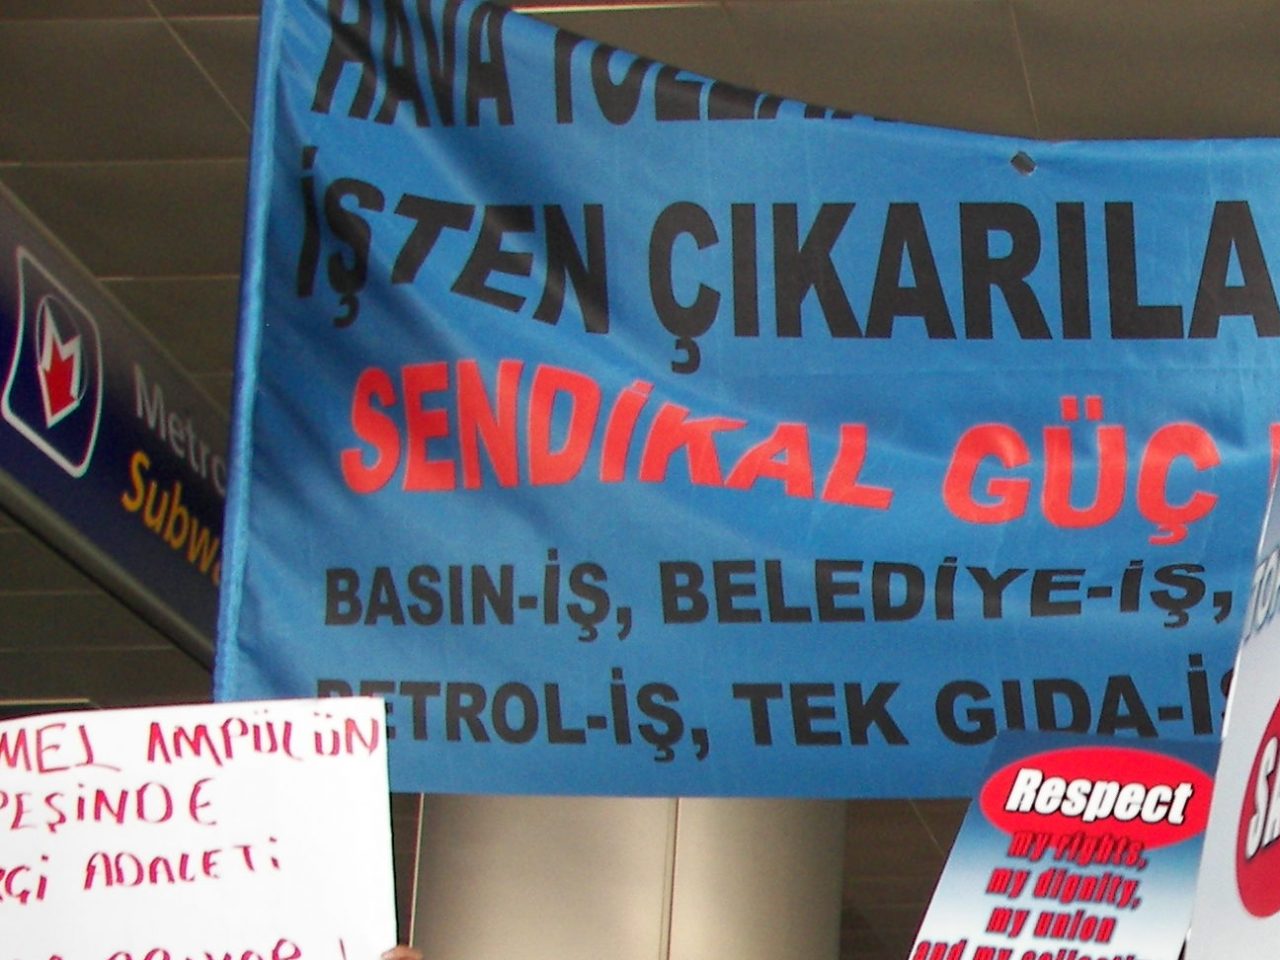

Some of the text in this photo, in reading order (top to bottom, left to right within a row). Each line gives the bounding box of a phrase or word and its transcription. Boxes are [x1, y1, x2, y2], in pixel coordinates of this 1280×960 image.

[297, 146, 610, 335] İŞTEN
[340, 358, 893, 509] SENDİKAL
[942, 395, 1221, 546] GÜÇ
[121, 450, 222, 588] Subw
[324, 548, 633, 643] BASIN-İŞ,
[658, 555, 1234, 629] BELEDİYE-İŞ,
[732, 682, 909, 748] TEK
[934, 654, 1232, 748] GIDA-İ
[1005, 768, 1193, 824] Respect
[986, 867, 1141, 910] my dignity,
[986, 906, 1117, 943] my union
